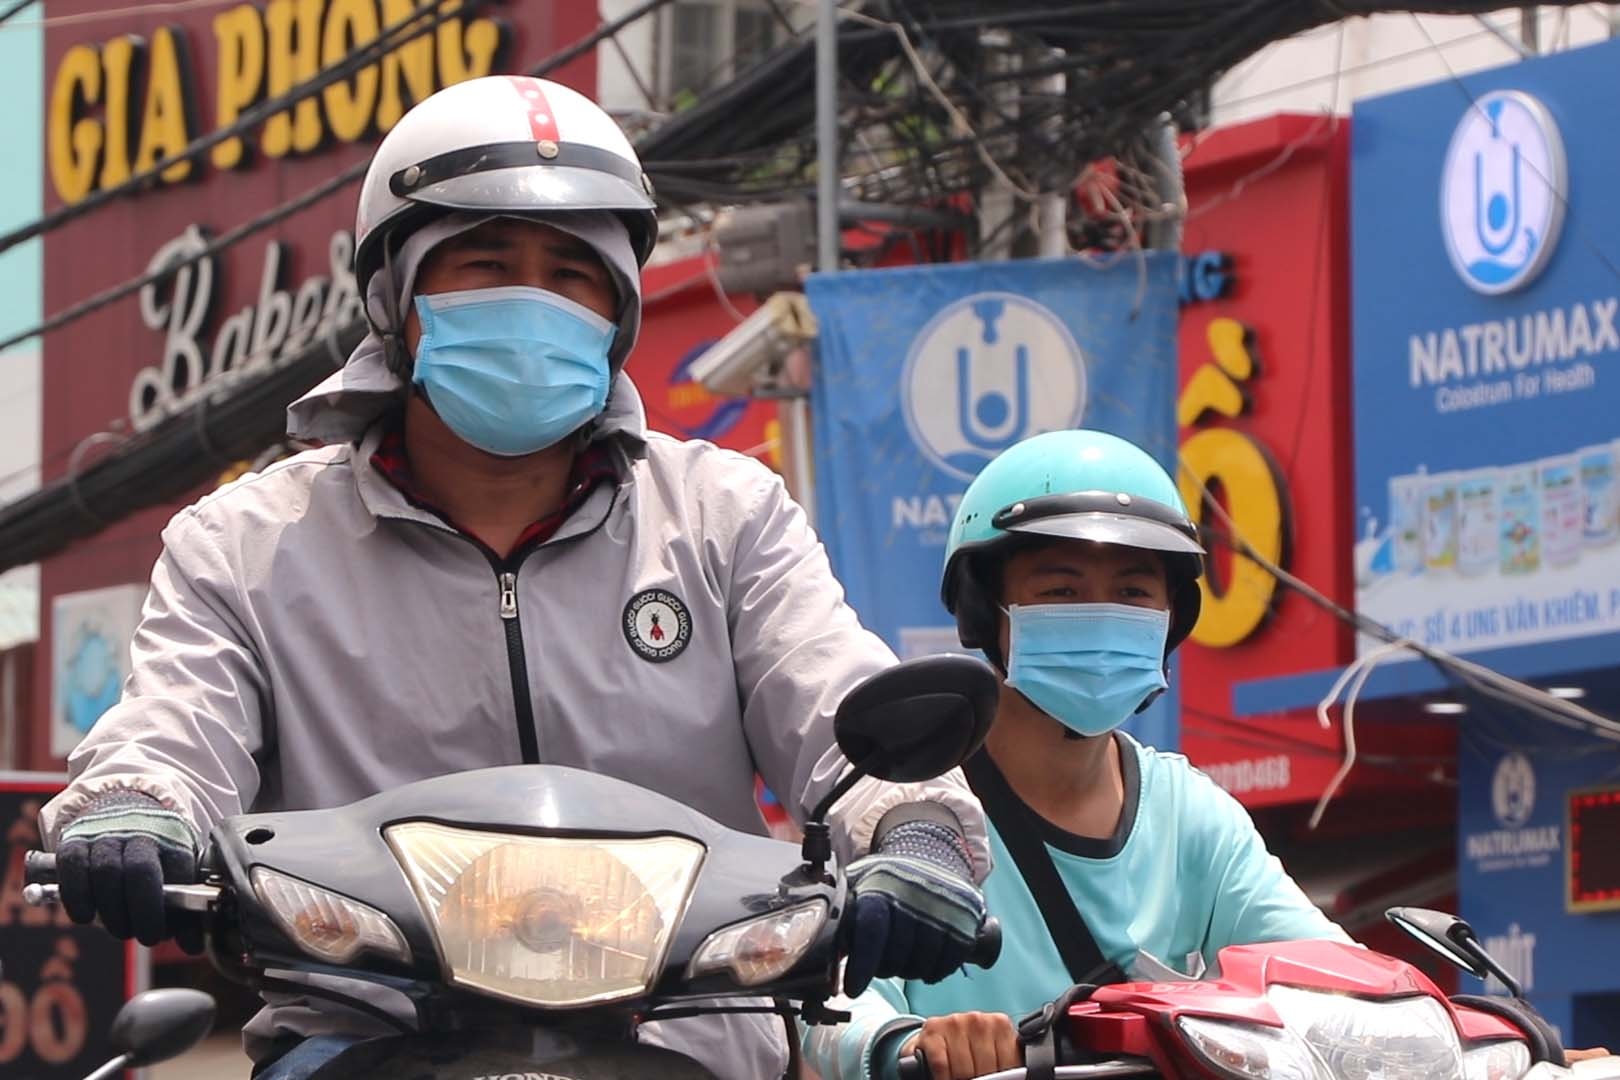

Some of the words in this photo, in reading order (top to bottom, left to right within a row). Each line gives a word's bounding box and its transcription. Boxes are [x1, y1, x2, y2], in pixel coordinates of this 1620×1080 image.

[49, 27, 193, 205] GIA
[210, 0, 499, 169] PHONG
[1408, 296, 1619, 389] NATRUMAX
